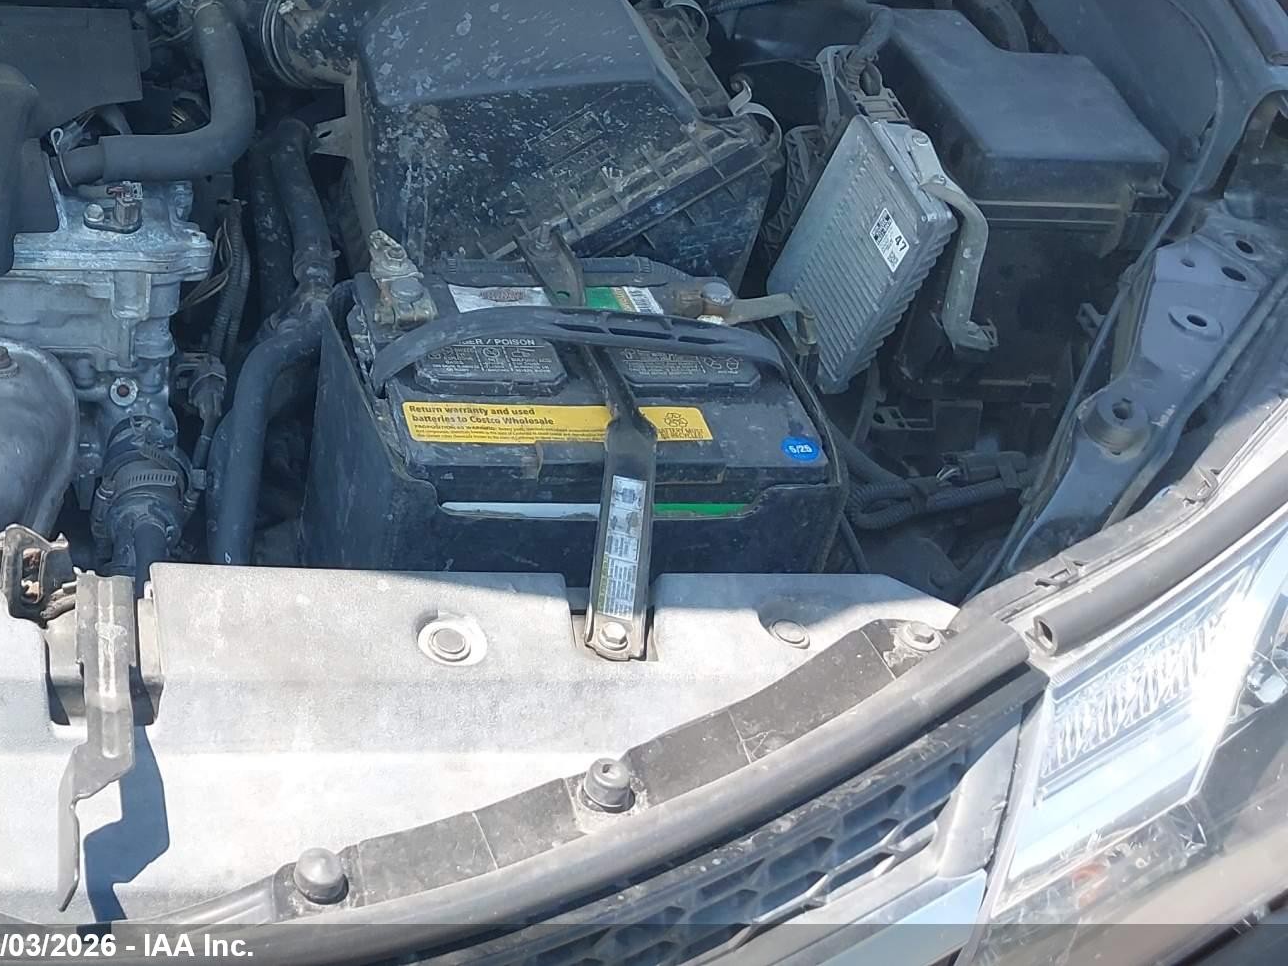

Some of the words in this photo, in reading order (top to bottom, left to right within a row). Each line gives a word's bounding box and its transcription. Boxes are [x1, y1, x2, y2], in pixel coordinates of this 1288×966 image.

[895, 235, 907, 251] 47
[495, 338, 536, 346] POISON
[409, 405, 443, 414] Return
[445, 407, 489, 416] warranty
[512, 408, 536, 416] used
[412, 415, 456, 424] batteries
[458, 416, 468, 424] to
[470, 416, 501, 425] Costco
[503, 417, 555, 426] Wholesale
[788, 444, 813, 454] 5/25
